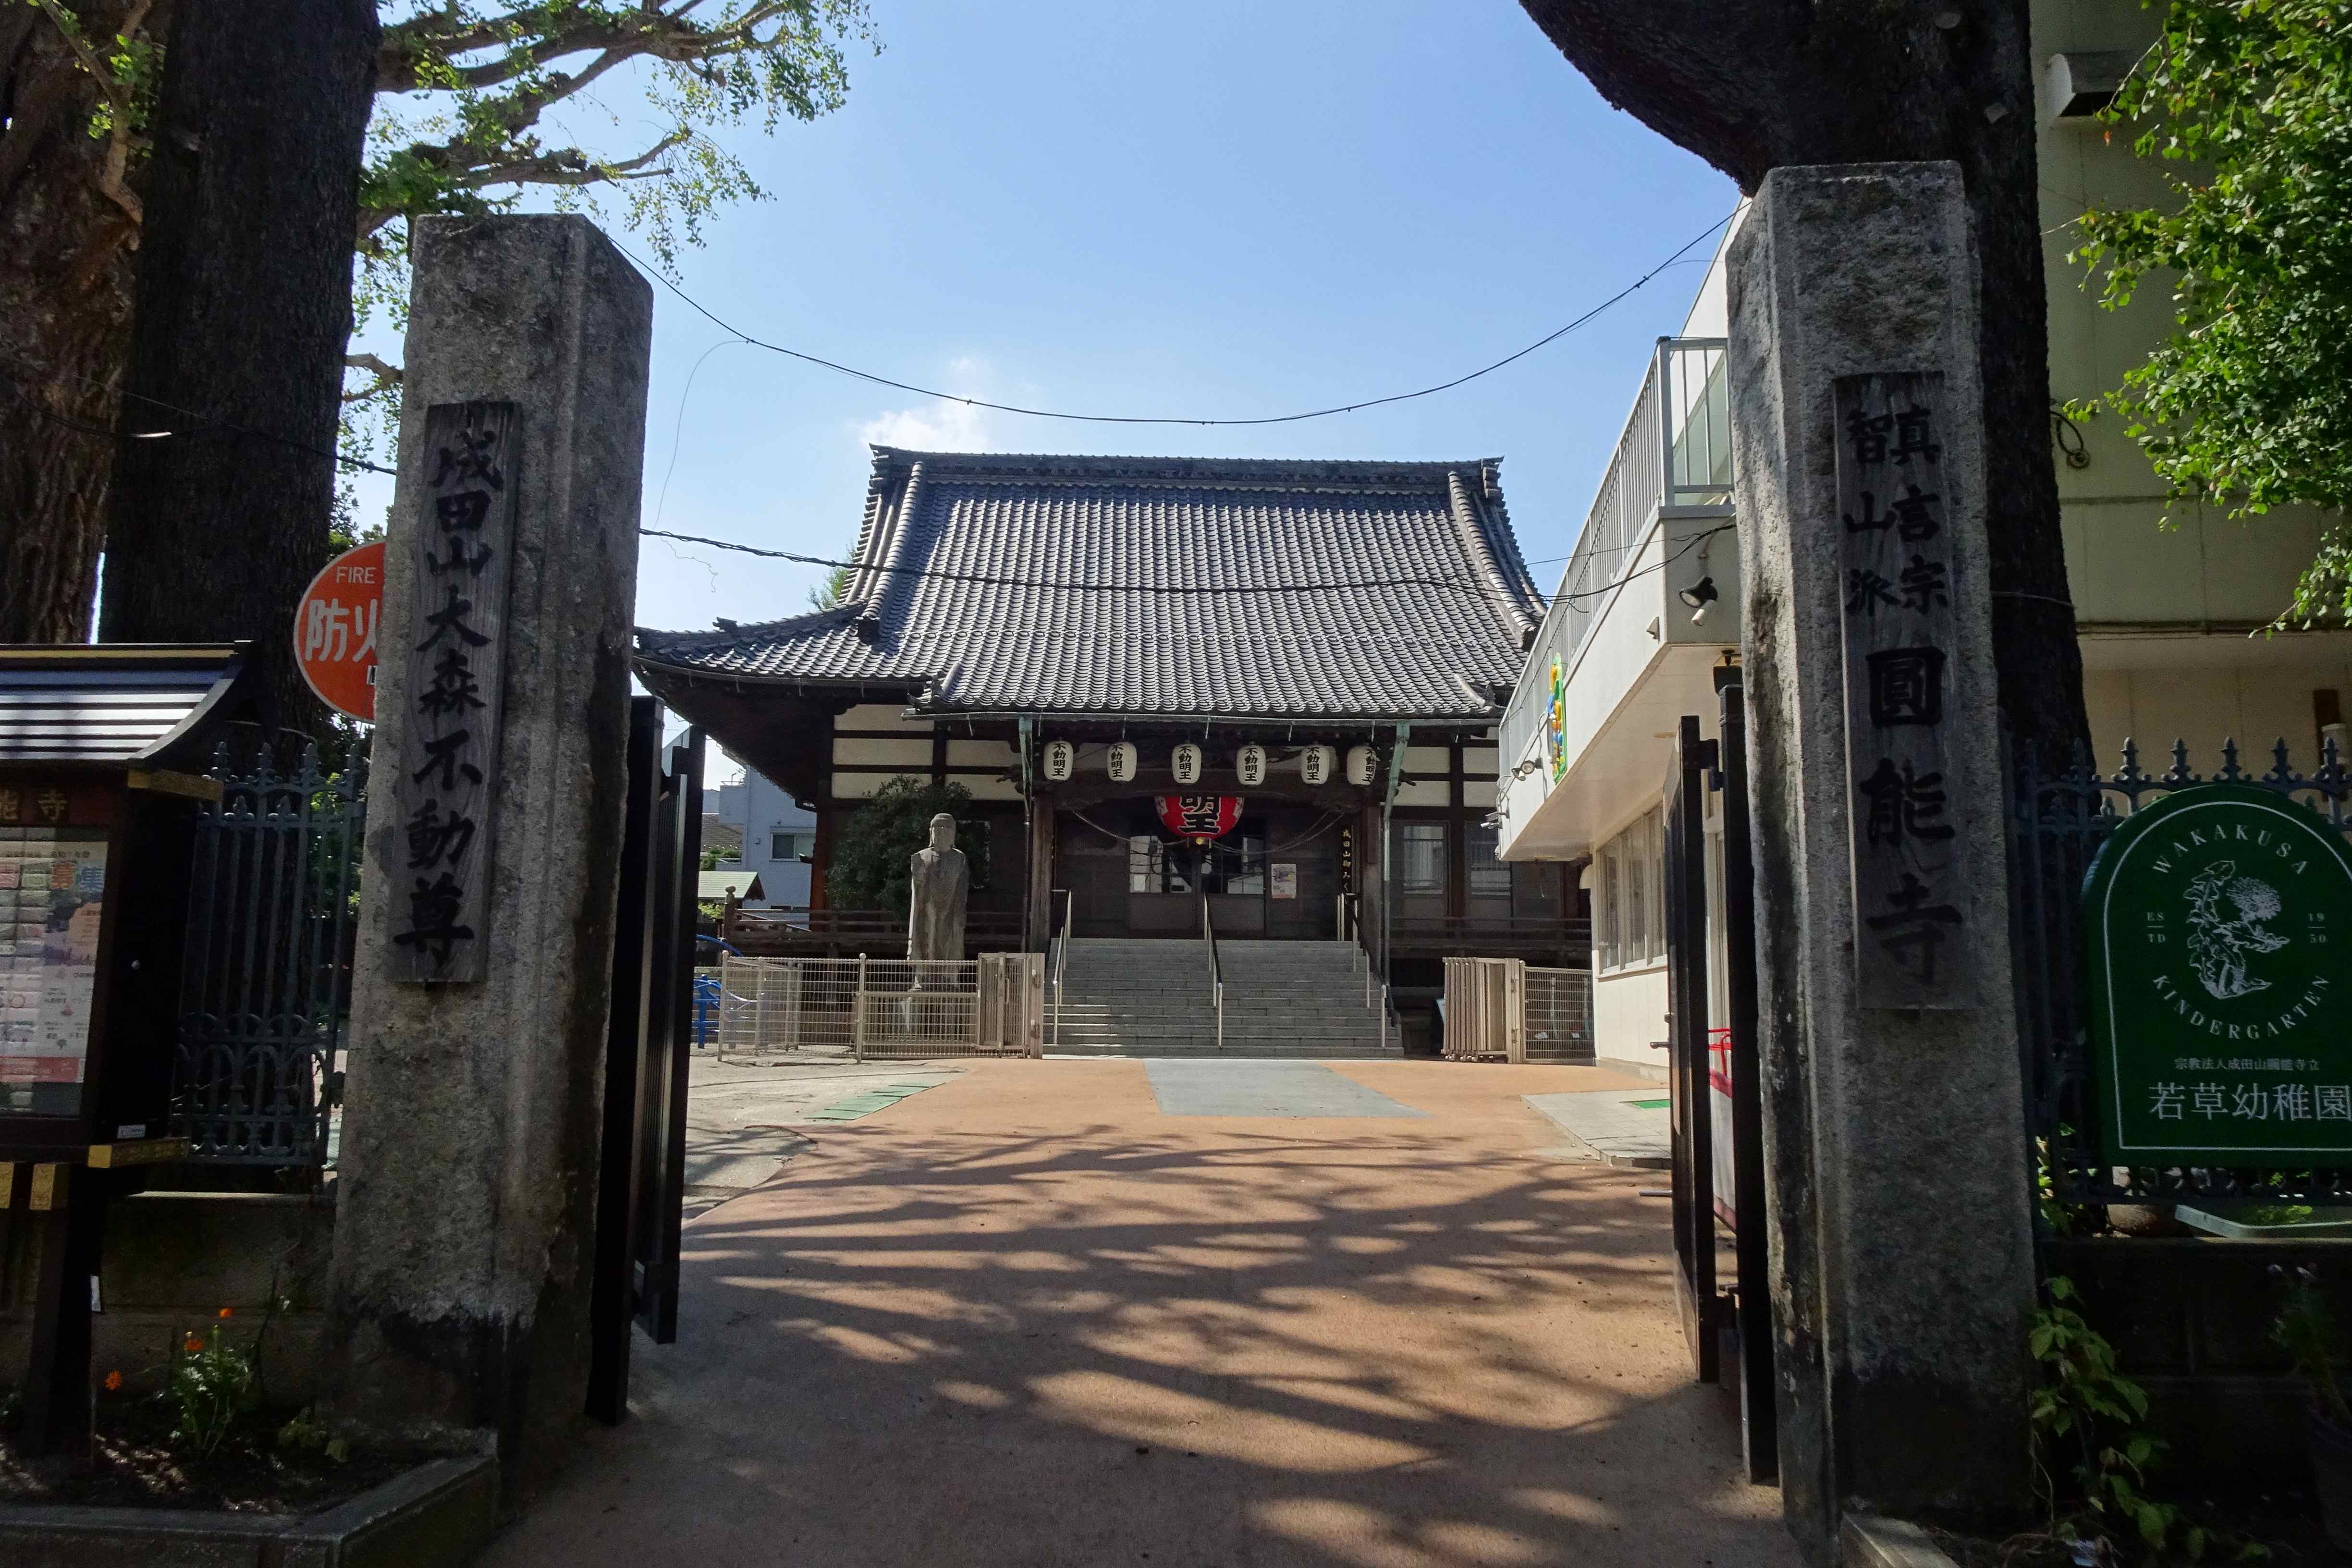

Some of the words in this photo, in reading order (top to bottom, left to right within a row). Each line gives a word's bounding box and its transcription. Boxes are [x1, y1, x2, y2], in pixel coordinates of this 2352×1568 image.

[1843, 408, 1900, 616] 智山派
[336, 566, 377, 584] FIRE
[395, 429, 502, 961] 成田山大森不動尊
[1053, 743, 1066, 777] 不動明王
[1110, 744, 1123, 777] 不動明王
[1179, 746, 1191, 780] 不動明王
[1244, 748, 1258, 781] 不動明王
[1307, 747, 1320, 780] 不動明王
[1859, 646, 1963, 985] 圓能寺
[2152, 824, 2307, 874] WAKAKUSA
[2146, 911, 2164, 921] ES
[2307, 912, 2325, 922] 19
[2146, 933, 2166, 943] TD
[2152, 975, 2329, 1040] KINDERGARTEN
[2148, 1082, 2352, 1122] 若草幼稚園
